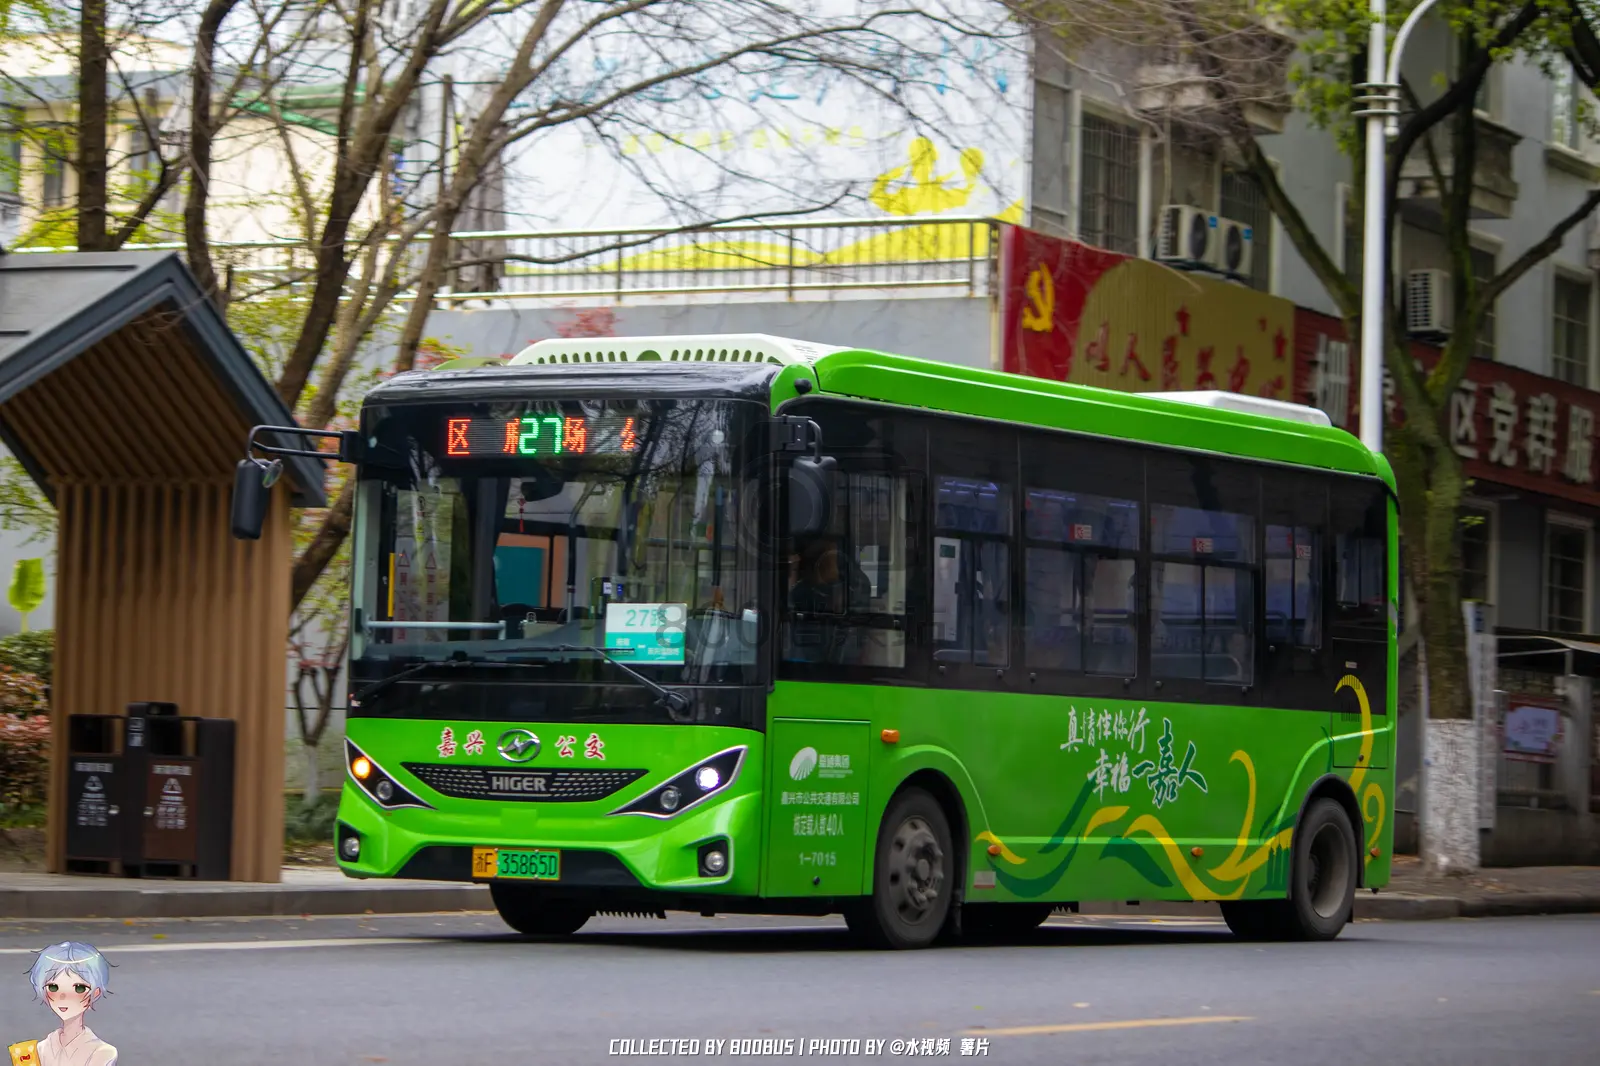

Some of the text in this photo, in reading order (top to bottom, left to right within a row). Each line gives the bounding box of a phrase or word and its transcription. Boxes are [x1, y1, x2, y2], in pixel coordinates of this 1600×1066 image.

[518, 417, 563, 455] 27
[437, 726, 607, 761] 嘉兴 公交
[1060, 705, 1150, 754] 真情伴你行
[491, 776, 547, 792] HIGER
[798, 851, 837, 866] 1-7015
